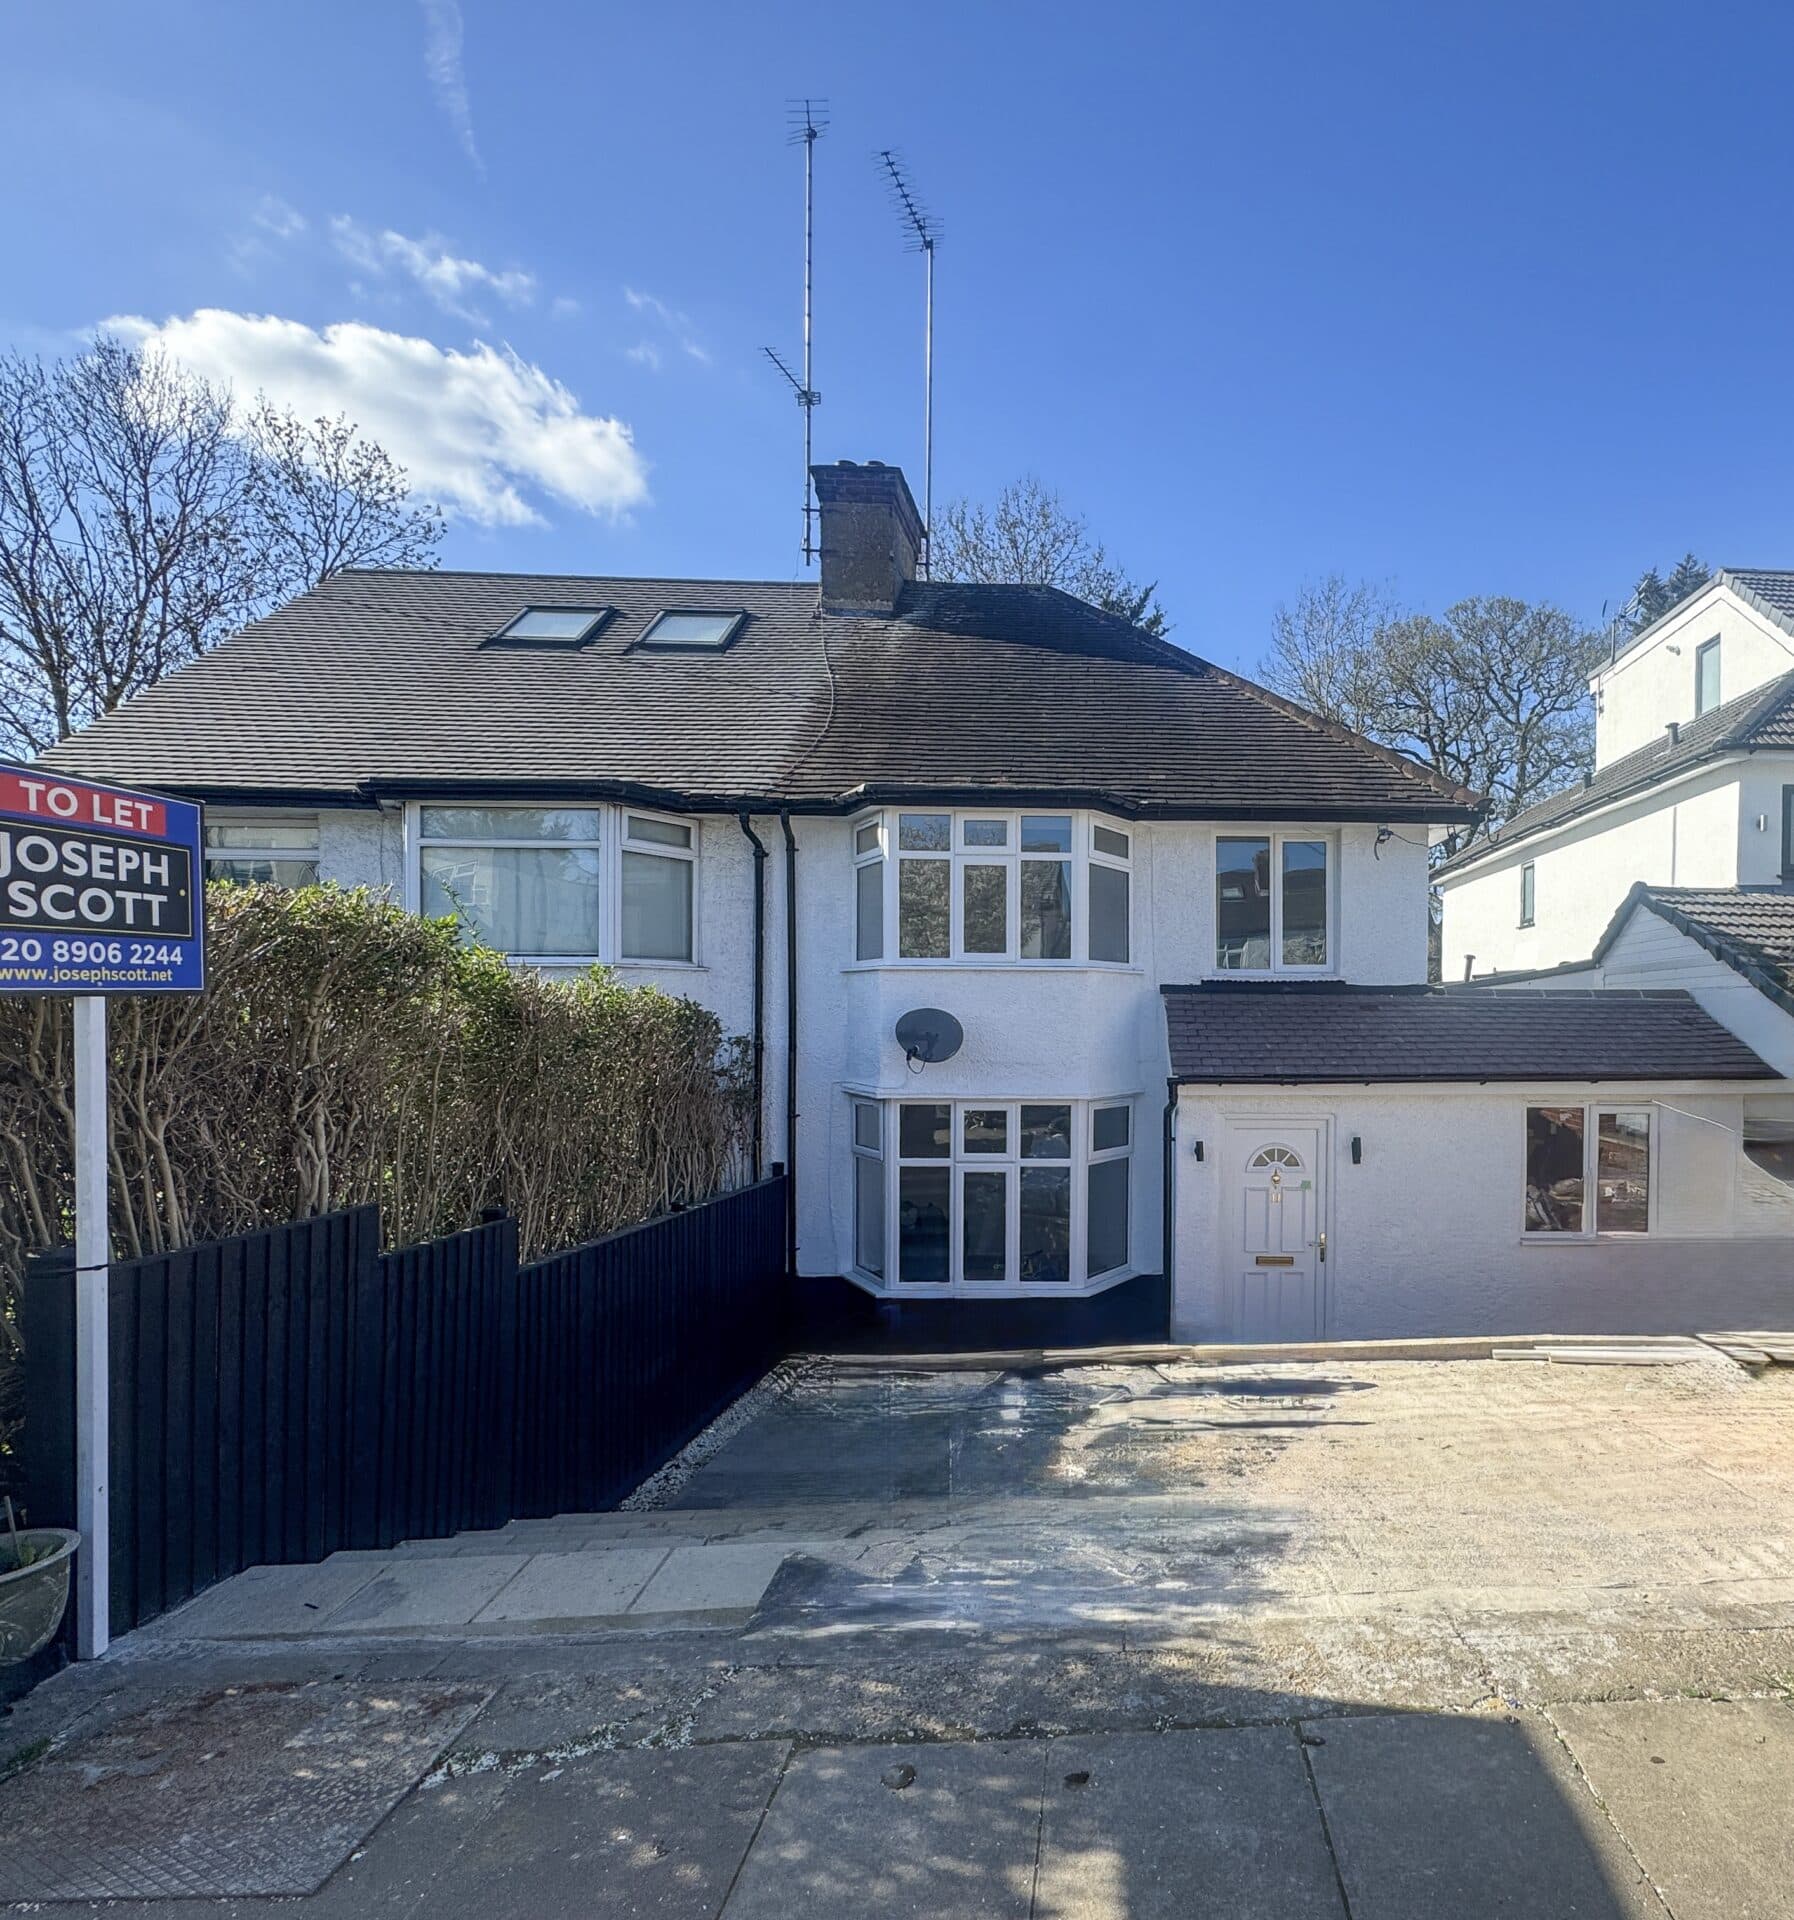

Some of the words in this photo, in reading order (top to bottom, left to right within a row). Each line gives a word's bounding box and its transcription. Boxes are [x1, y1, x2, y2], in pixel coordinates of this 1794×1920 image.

[19, 780, 79, 817] TO
[92, 794, 154, 831] LET
[0, 831, 170, 887] JOSEPH
[7, 880, 169, 927] SCOTT
[0, 965, 174, 984] www.josephscott.net
[52, 940, 123, 964] 8906
[129, 944, 183, 966] 2244
